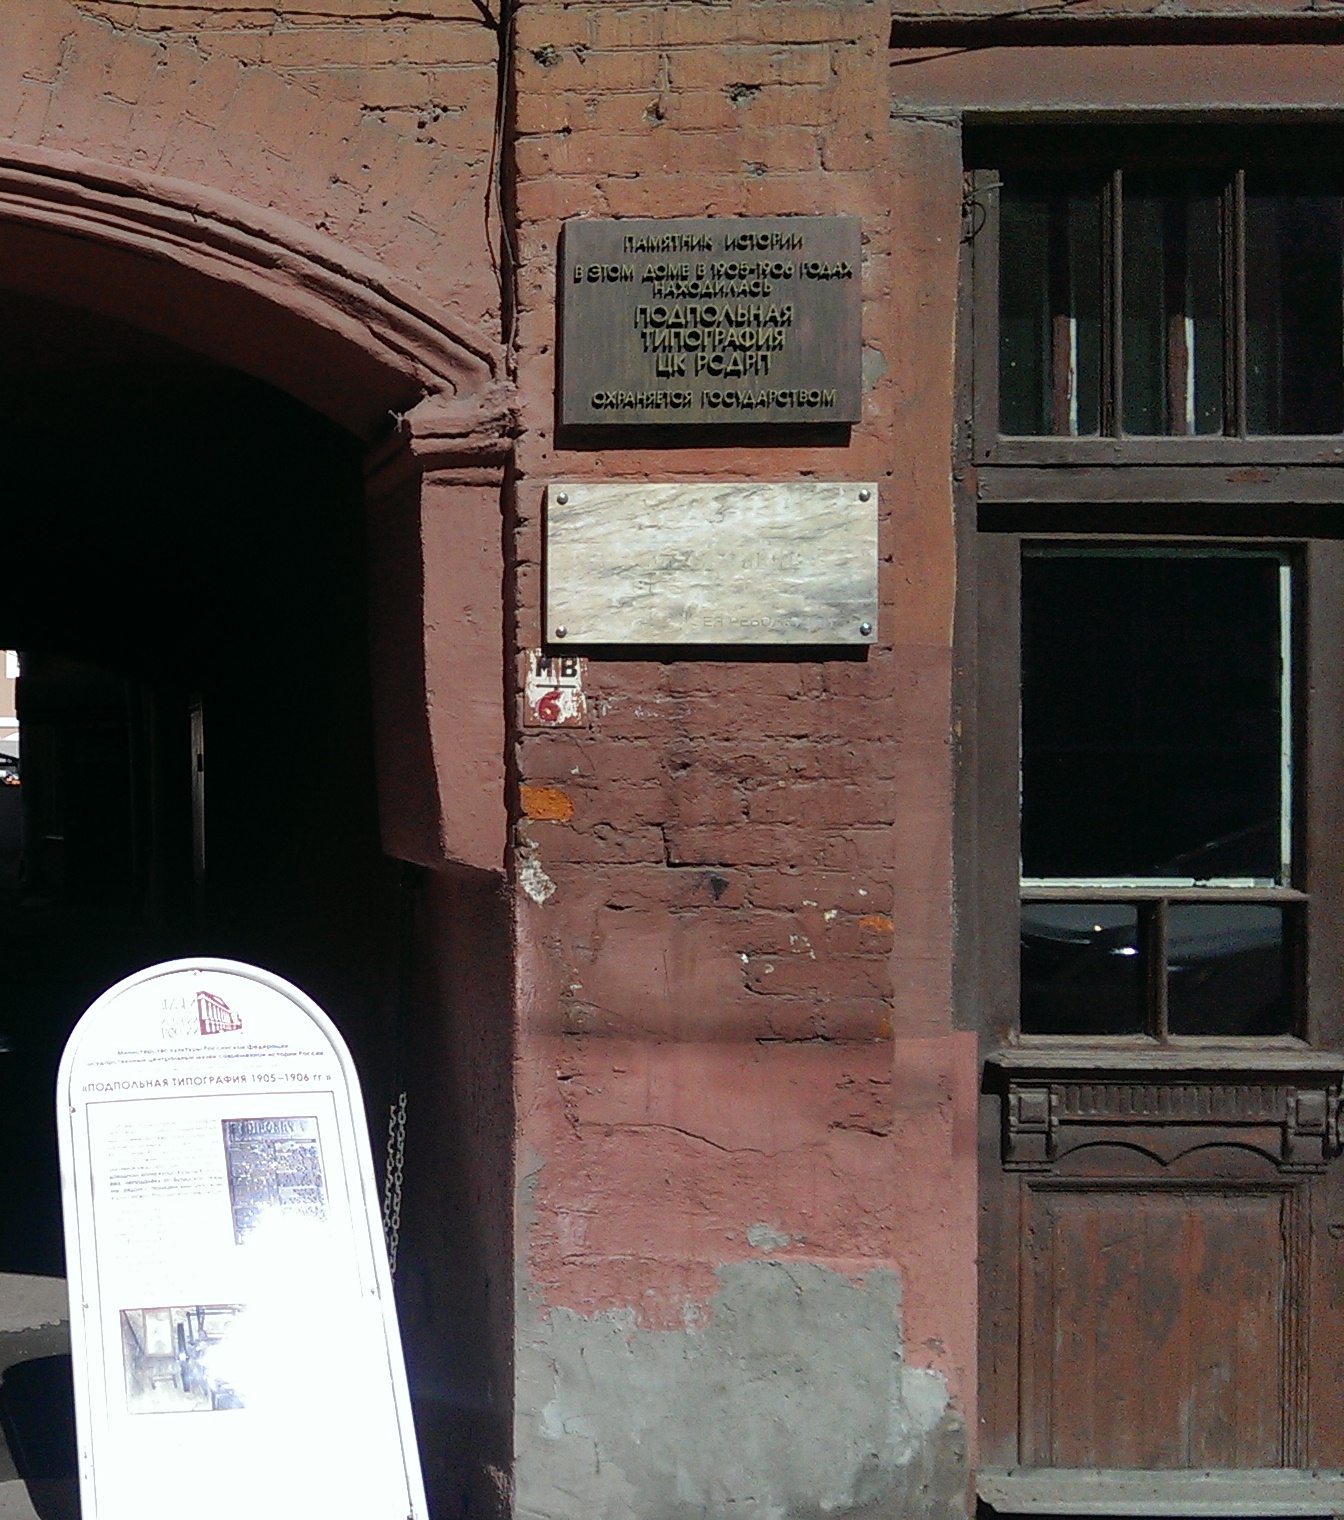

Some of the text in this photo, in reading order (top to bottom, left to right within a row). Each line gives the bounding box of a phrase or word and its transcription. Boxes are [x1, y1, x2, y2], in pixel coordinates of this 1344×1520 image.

[624, 232, 804, 252] ПАМЯТНИК ИСТОРИИ
[574, 261, 853, 283] В ЭТОМ ДОМЕ В 1905-1906 ГОДАХ
[653, 280, 773, 299] НАХОДИЛАСЬ
[635, 304, 794, 328] ПОДПОЛЬНАЯ
[641, 328, 786, 352] ТИПОГРАФИЯ
[656, 352, 771, 378] ЦК РСДРП
[592, 389, 836, 409] ОХРАНЯЕТСЯ ГОСУДАРСТВОМ
[538, 692, 561, 721] 6
[172, 1075, 247, 1087] ТИПОГРАФИЯ
